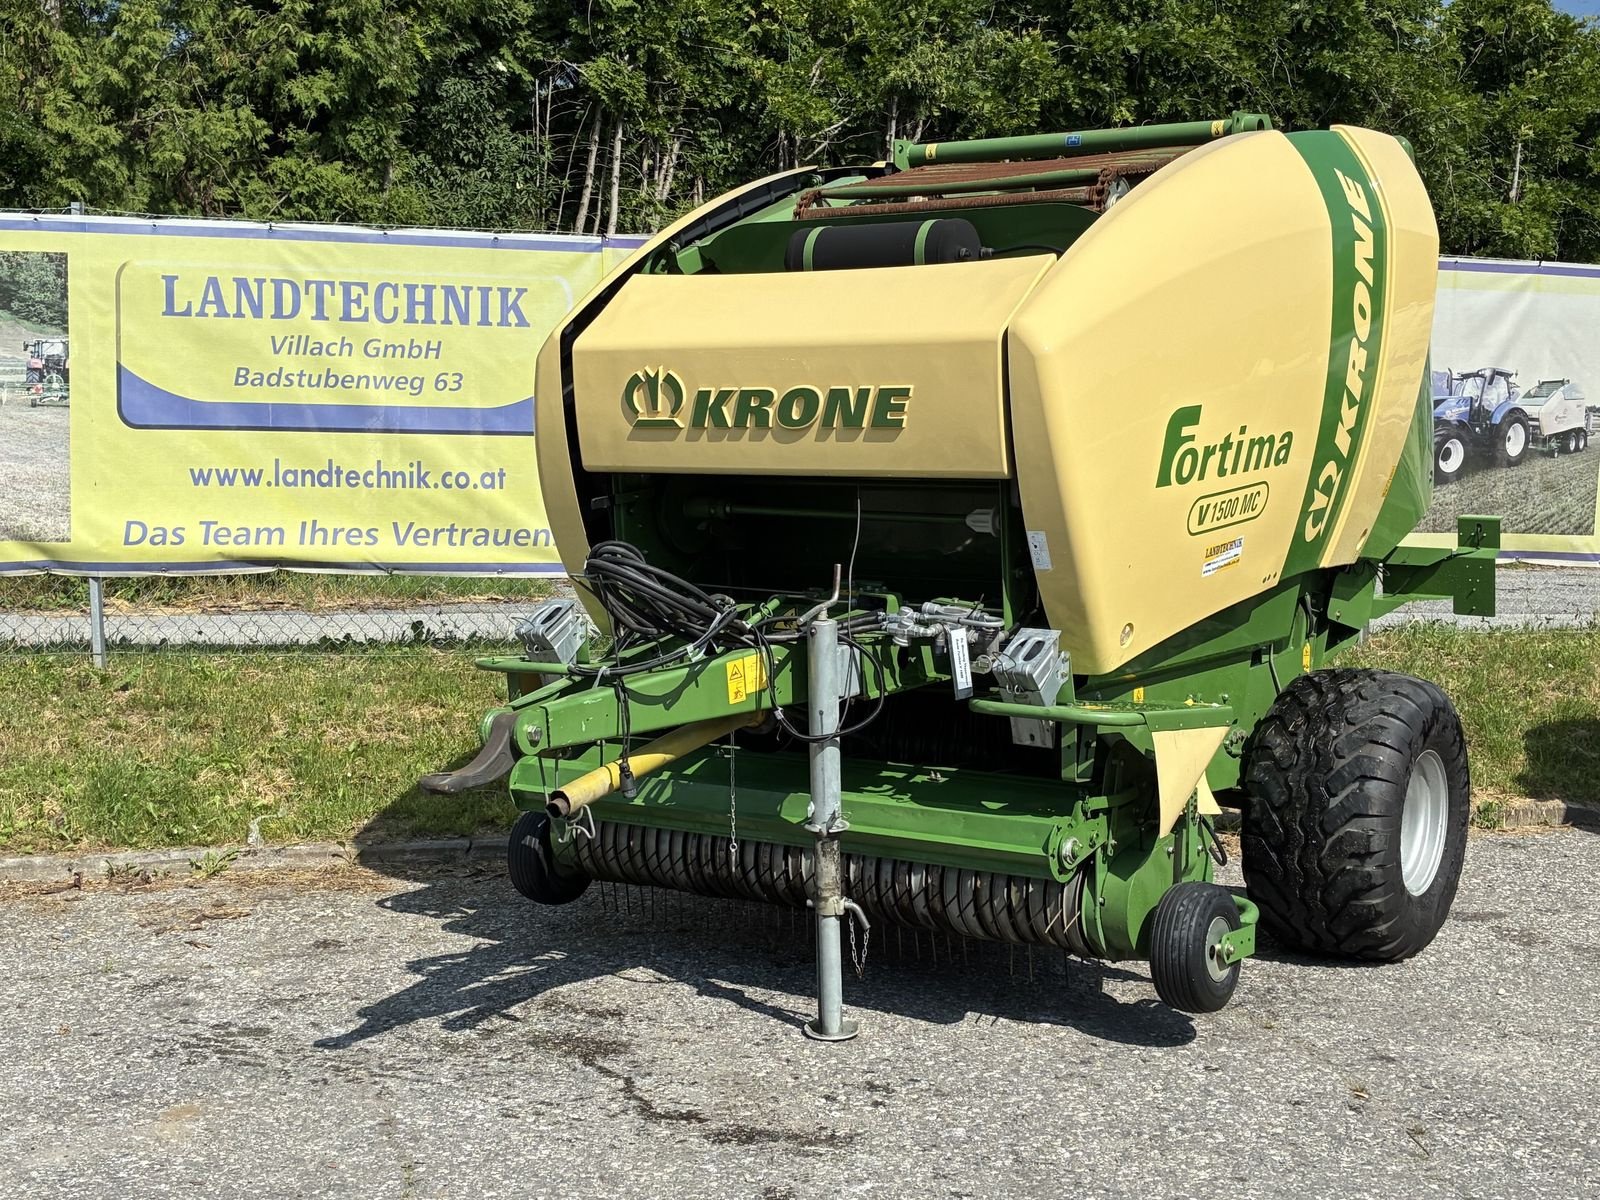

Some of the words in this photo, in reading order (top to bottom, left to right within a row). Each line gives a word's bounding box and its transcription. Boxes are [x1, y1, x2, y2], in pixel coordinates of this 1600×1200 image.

[162, 274, 530, 328] LANDTECHNIK
[1333, 167, 1374, 458] KRONE
[270, 335, 354, 359] Villach
[363, 339, 443, 361] GmbH
[233, 367, 425, 396] Badstubenweg
[433, 372, 464, 392] 63
[690, 385, 914, 430] KRONE
[1155, 404, 1294, 488] Fortima
[189, 460, 507, 489] www.landtechnik.co.at
[1197, 503, 1211, 526] V
[1210, 496, 1240, 523] 1500
[1239, 490, 1261, 515] MC
[123, 520, 186, 546] Das
[199, 520, 286, 546] Team
[299, 520, 379, 547] Ihres
[392, 521, 557, 548] Vertrauen
